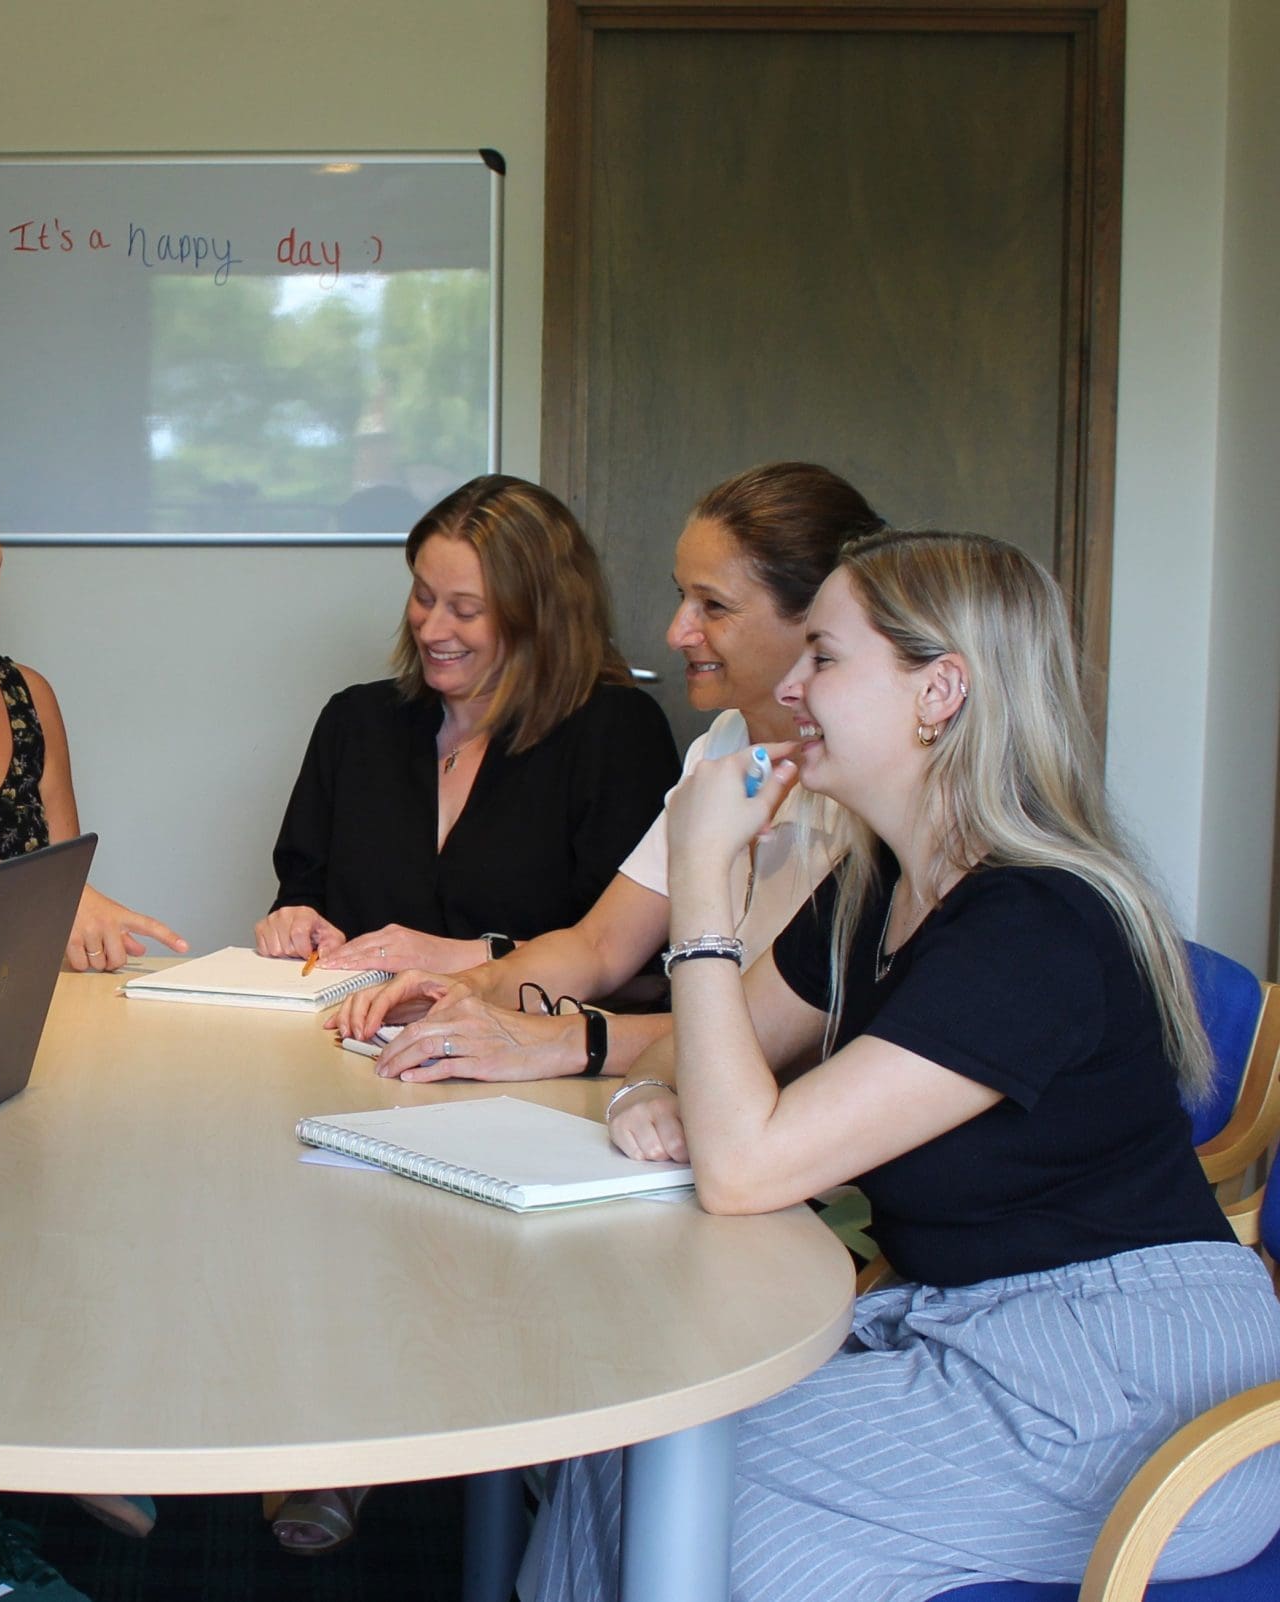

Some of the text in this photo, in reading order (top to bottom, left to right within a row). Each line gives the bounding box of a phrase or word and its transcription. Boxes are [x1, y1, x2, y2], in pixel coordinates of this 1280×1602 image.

[9, 218, 74, 252] It's
[88, 230, 111, 249] a
[128, 223, 243, 286] happy
[276, 227, 341, 290] day
